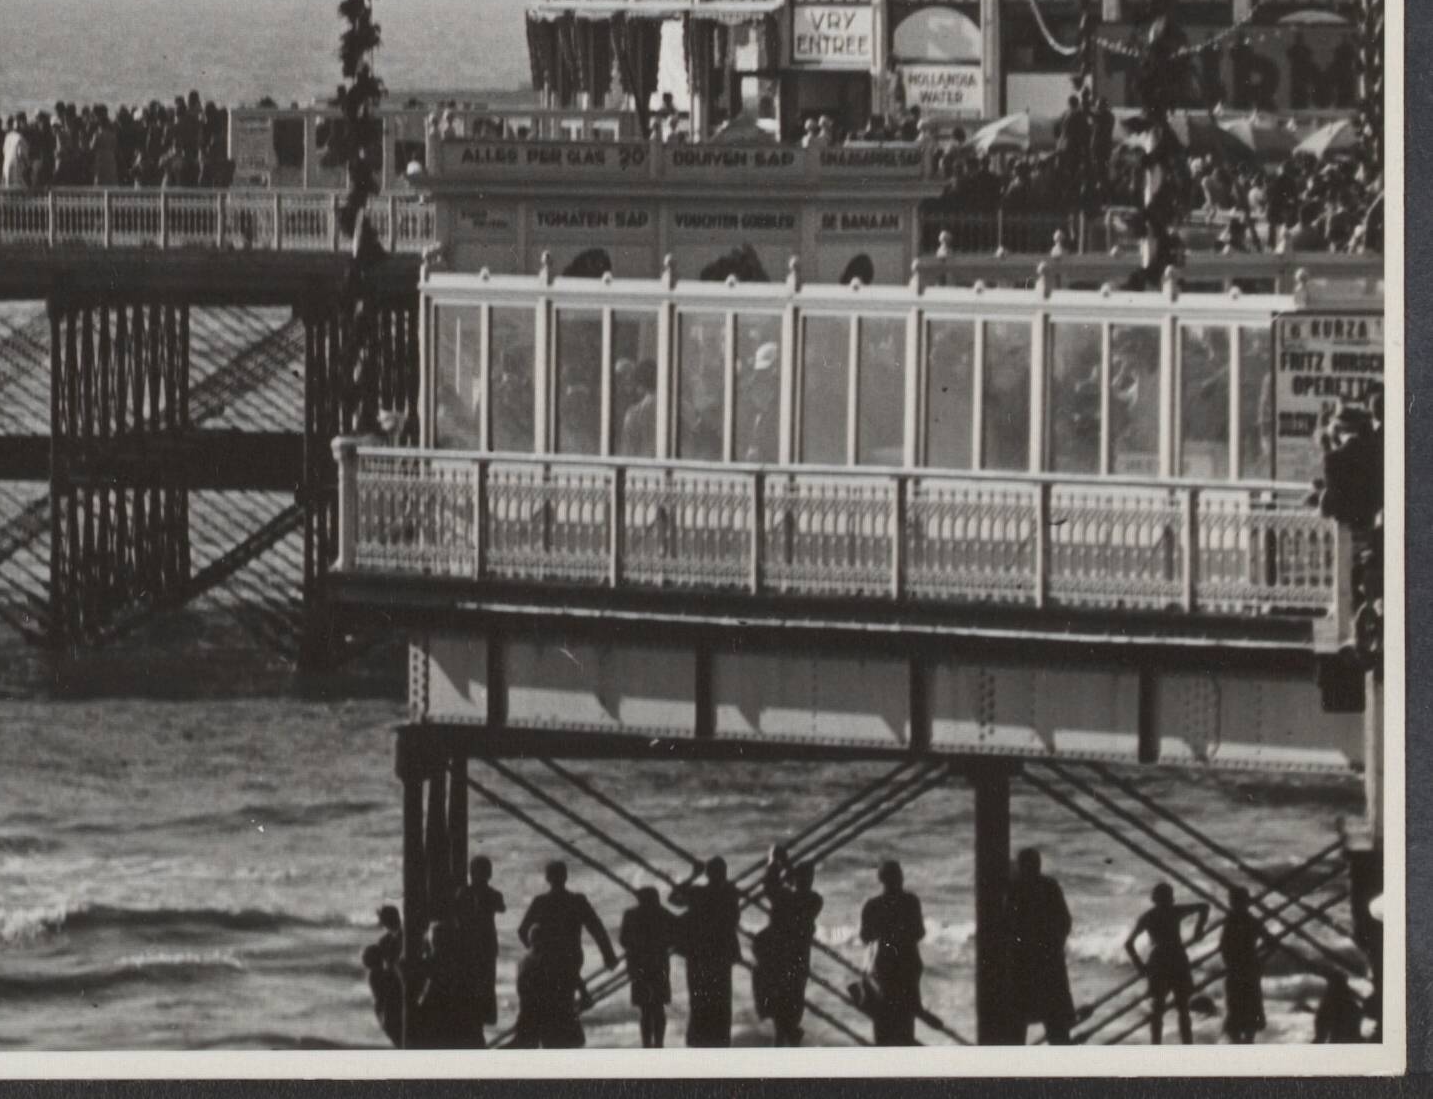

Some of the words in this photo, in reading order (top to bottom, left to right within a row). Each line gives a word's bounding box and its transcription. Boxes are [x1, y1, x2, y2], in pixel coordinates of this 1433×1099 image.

[810, 10, 856, 31] VRY
[796, 34, 869, 55] ENTREE
[908, 73, 977, 87] HOLLANDIA
[920, 90, 963, 103] WATER
[840, 213, 900, 229] BANAAN
[1280, 351, 1325, 372] FRITZ
